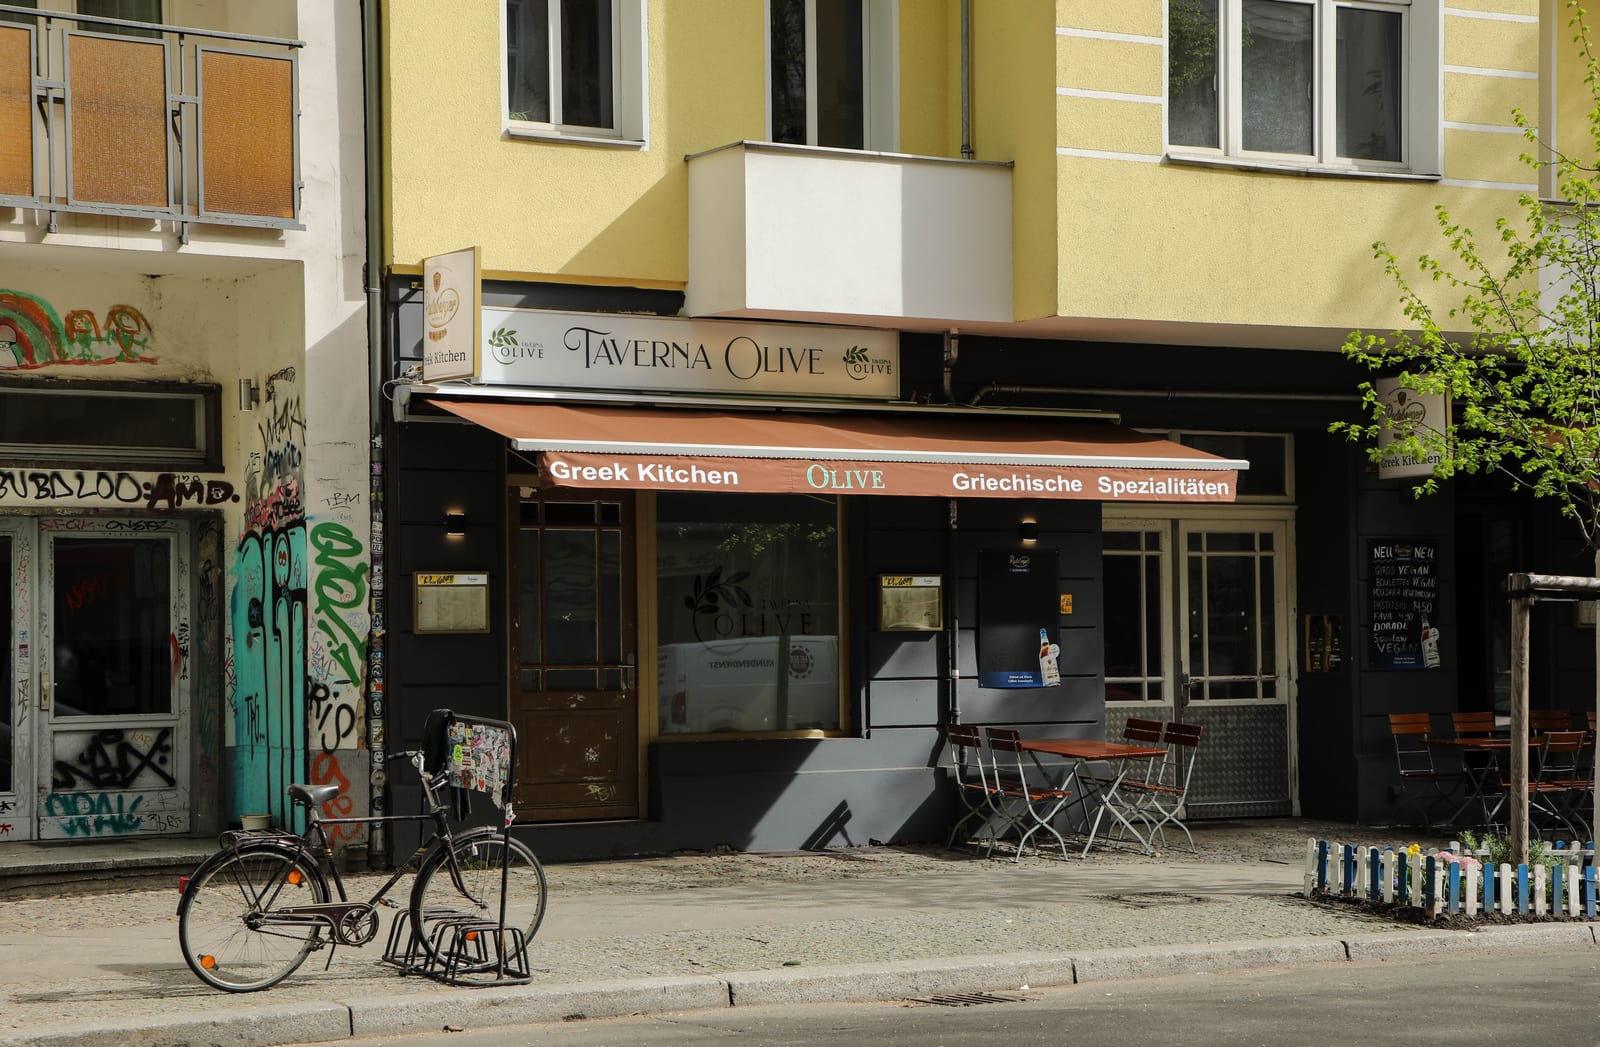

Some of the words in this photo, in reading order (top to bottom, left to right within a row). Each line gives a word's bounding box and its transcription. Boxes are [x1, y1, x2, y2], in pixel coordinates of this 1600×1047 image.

[434, 349, 466, 365] Kitchen
[500, 346, 544, 359] OLIVE
[563, 326, 712, 369] TAVERNA
[724, 336, 825, 380] OLIVE
[853, 363, 893, 375] OLIVE
[1402, 454, 1441, 467] Kiten
[549, 460, 631, 482] Greek
[637, 462, 739, 486] Kitchen
[806, 463, 886, 490] OLIVE
[952, 471, 1083, 493] Griechische
[1097, 475, 1230, 498] Spezialitäten
[1398, 565, 1430, 575] VEGAN
[1412, 576, 1437, 588] VEGAN
[713, 613, 812, 636] OLIVE
[1377, 643, 1418, 653] VEGAN
